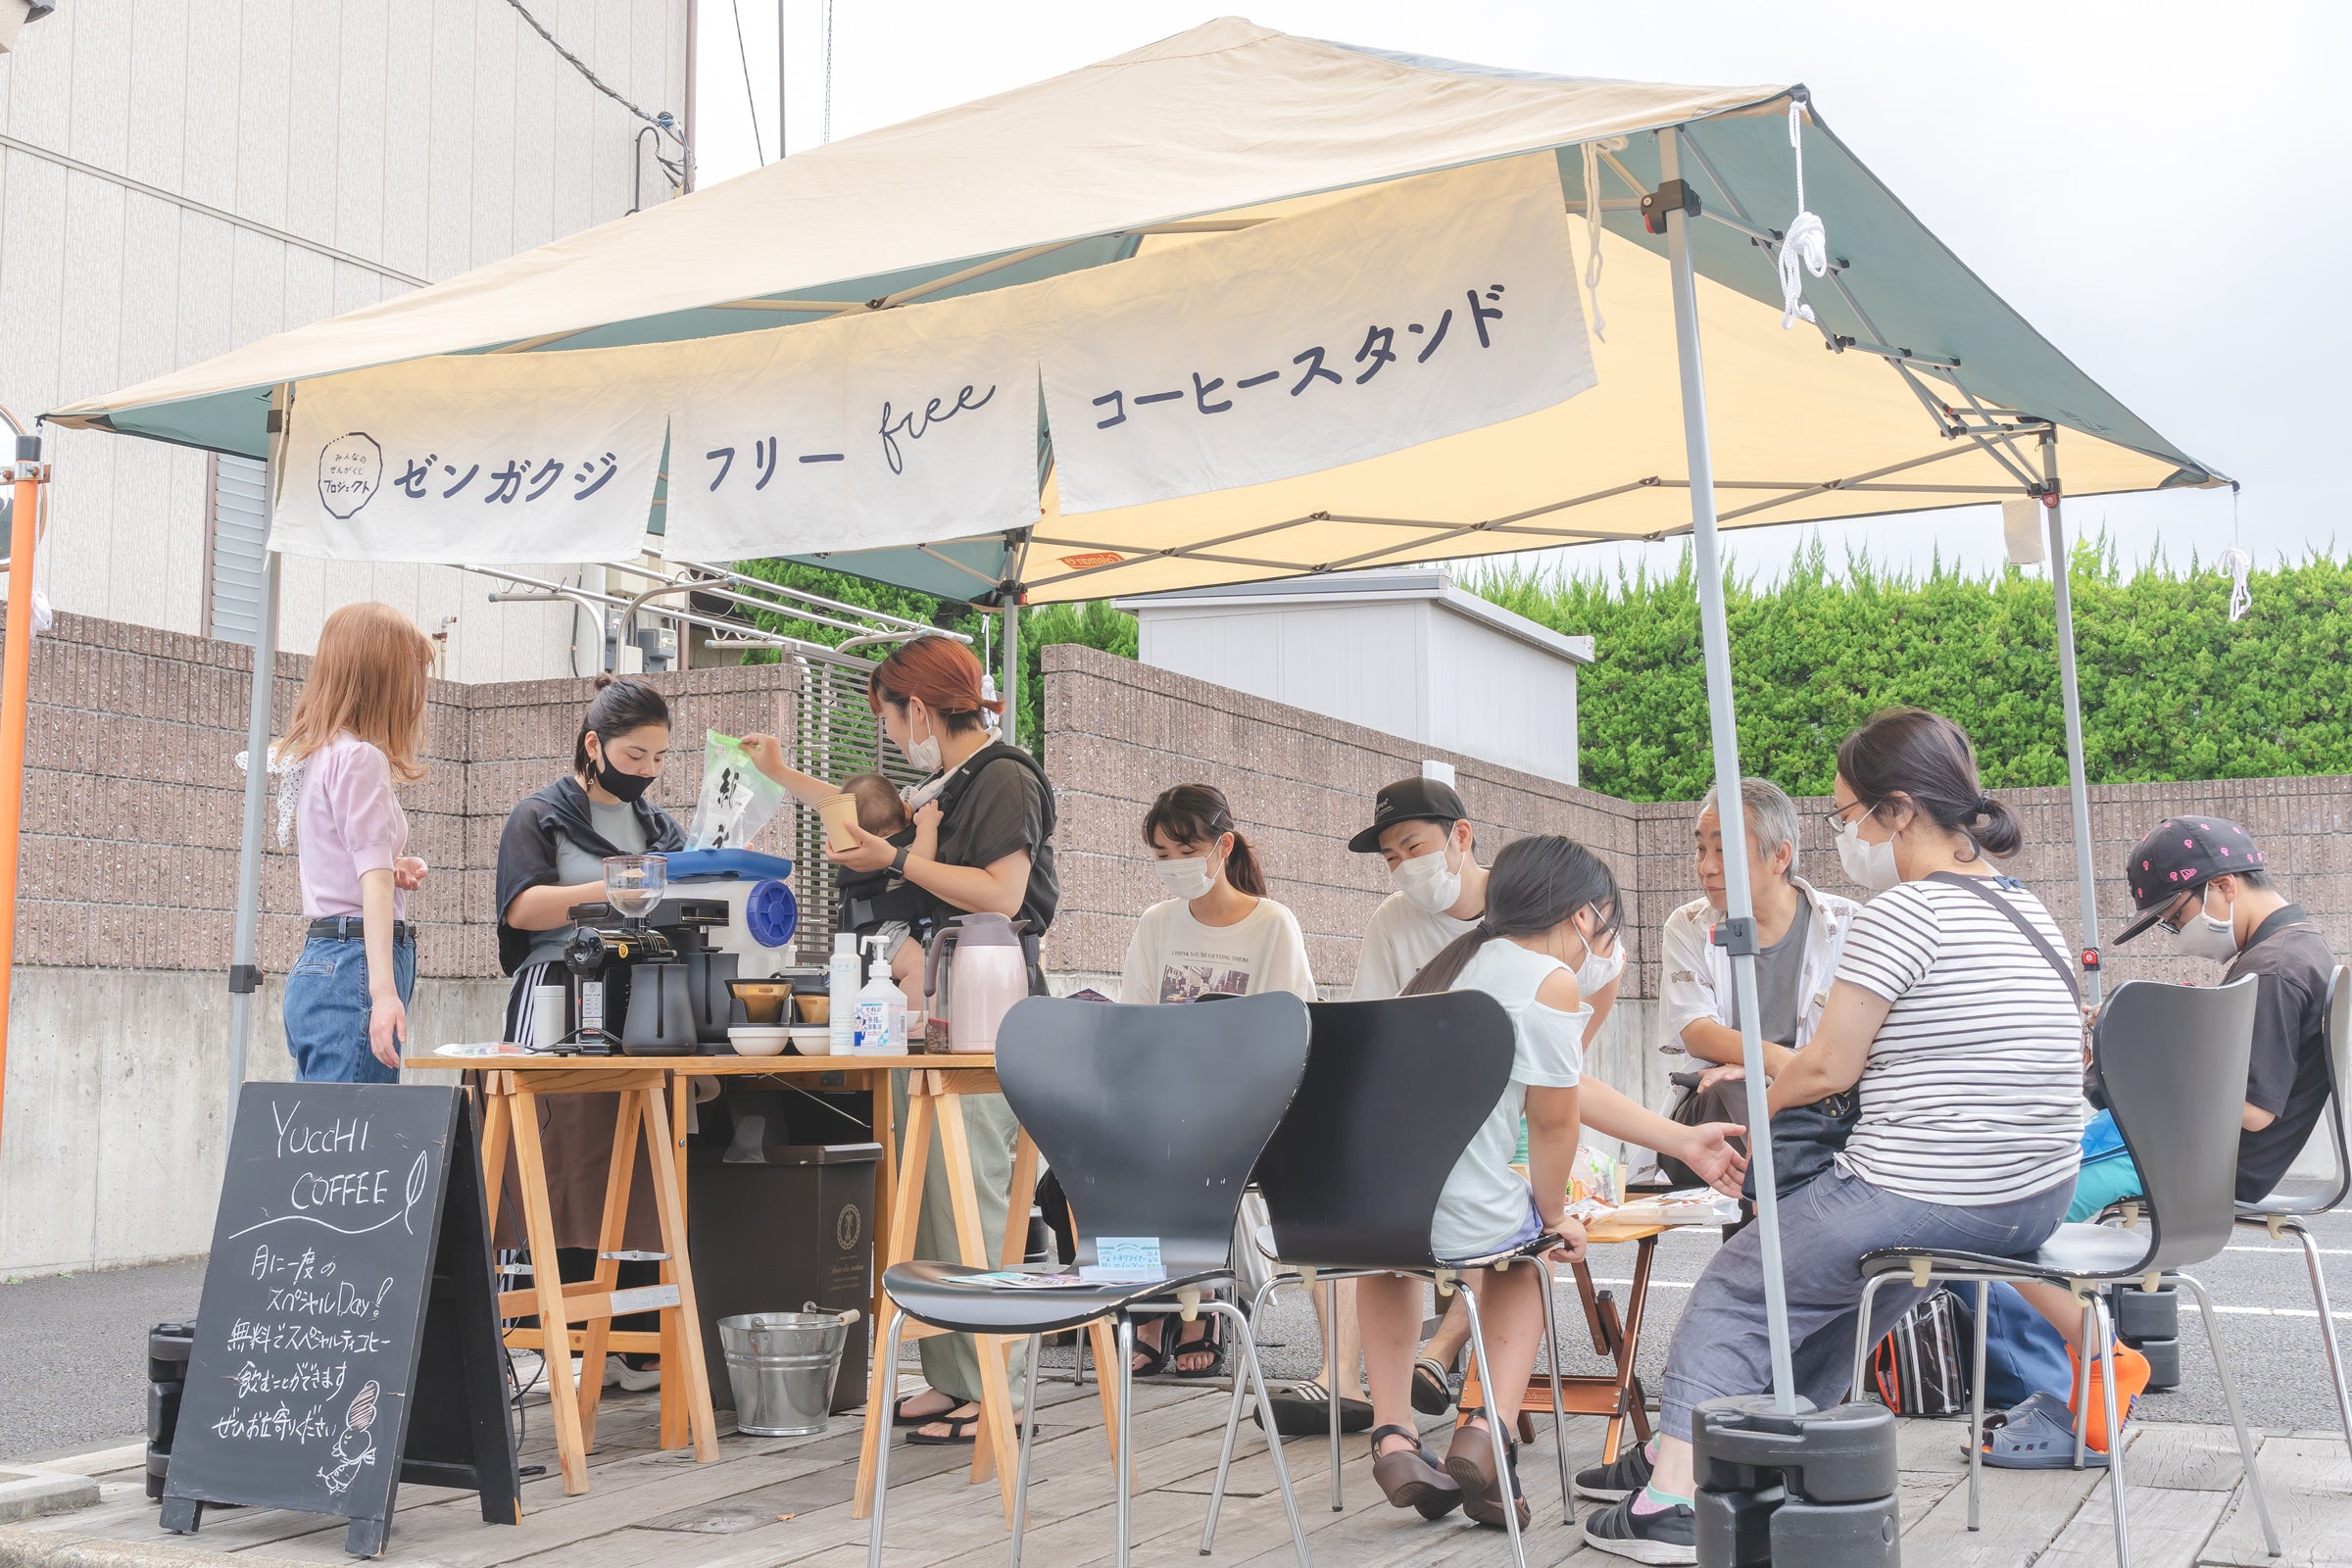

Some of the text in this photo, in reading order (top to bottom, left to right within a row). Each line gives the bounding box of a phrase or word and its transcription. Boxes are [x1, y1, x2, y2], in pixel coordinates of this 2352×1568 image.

[393, 282, 1506, 505] ゼンガクジ フリー free コーヒースタンド
[330, 466, 365, 476] ぜんがくじ
[335, 453, 368, 465] みんなの
[323, 479, 370, 495] プロジェクト
[291, 1169, 391, 1210] COFFEE
[251, 1244, 337, 1286] 月に一度の
[237, 1360, 348, 1401] 飲むことができます
[211, 1401, 337, 1446] ぜひお立寄りください
